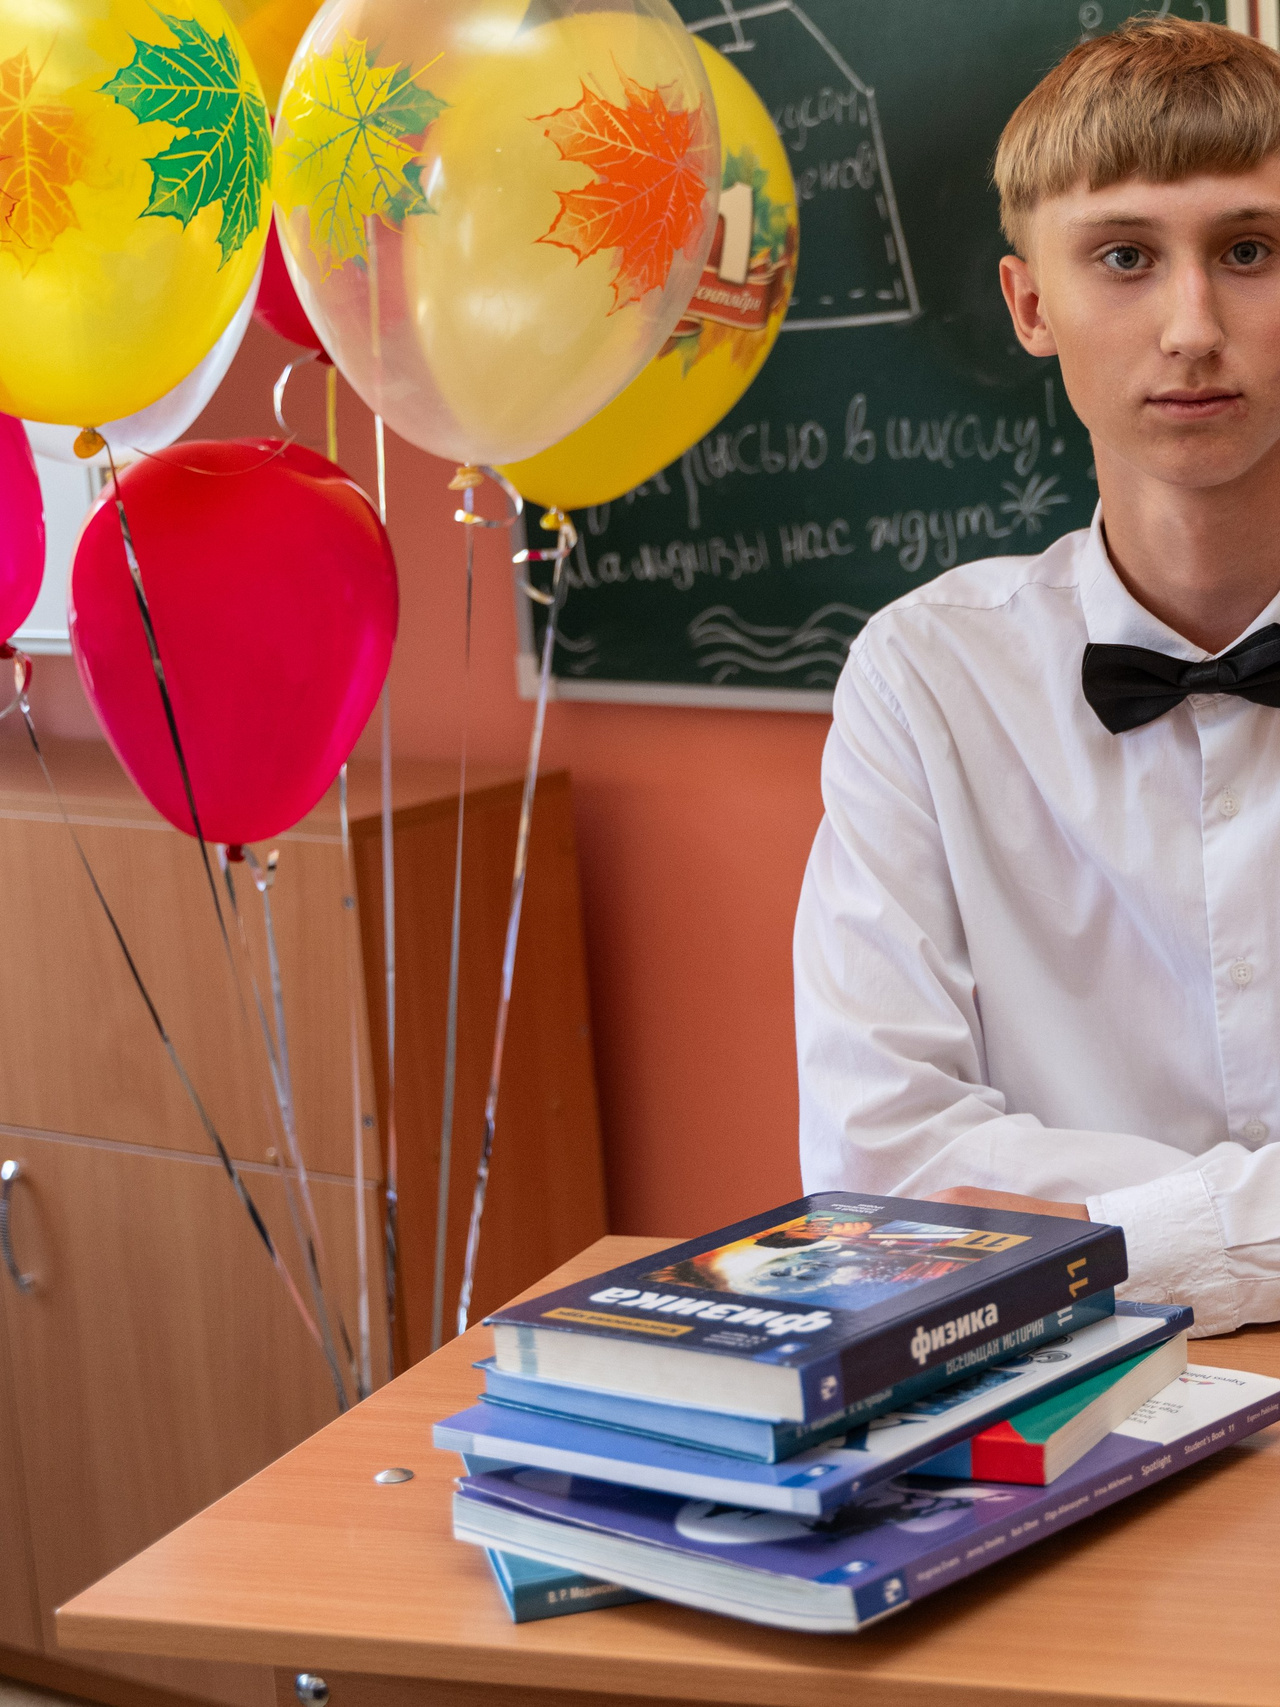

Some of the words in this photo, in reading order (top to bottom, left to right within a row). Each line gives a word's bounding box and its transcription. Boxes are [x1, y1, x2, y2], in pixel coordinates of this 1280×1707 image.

[719, 183, 753, 284] 1
[957, 1234, 1005, 1249] 11
[1066, 1256, 1090, 1298] 11
[588, 1286, 833, 1336] физика
[910, 1303, 998, 1365] физика
[1003, 1318, 1045, 1350] ИСТОРИЯ
[1057, 1305, 1074, 1326] 11
[1141, 1455, 1172, 1476] Spotlight
[1184, 1436, 1211, 1455] Student's
[1211, 1430, 1226, 1442] Book
[1228, 1423, 1235, 1432] 11
